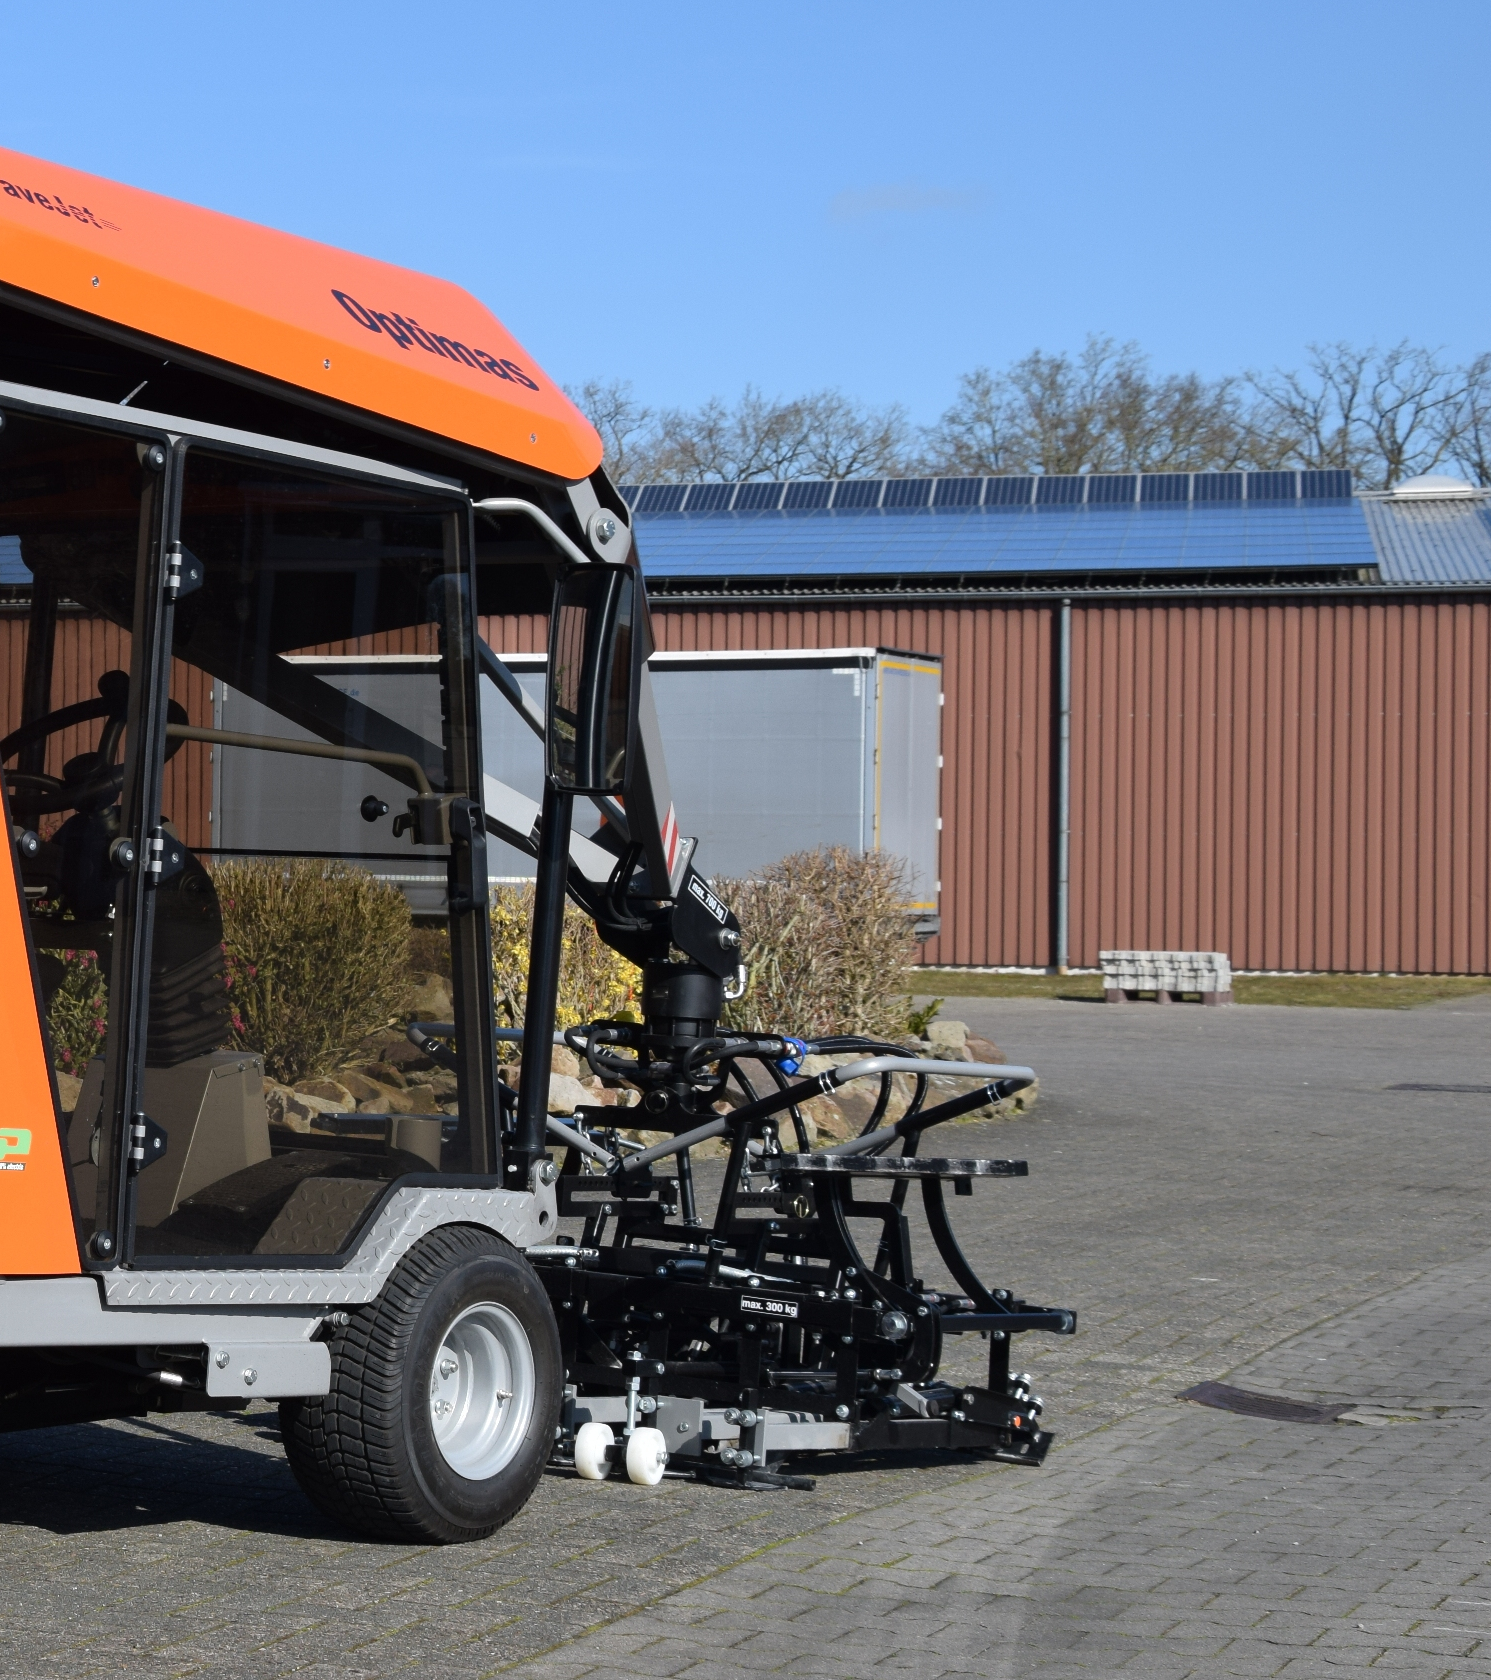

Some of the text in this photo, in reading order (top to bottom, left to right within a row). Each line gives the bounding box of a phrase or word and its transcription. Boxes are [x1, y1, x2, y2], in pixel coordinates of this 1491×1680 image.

[331, 289, 540, 391] Optimas
[691, 882, 724, 920] max. 700 kg
[742, 1300, 797, 1316] max. 300 kg
